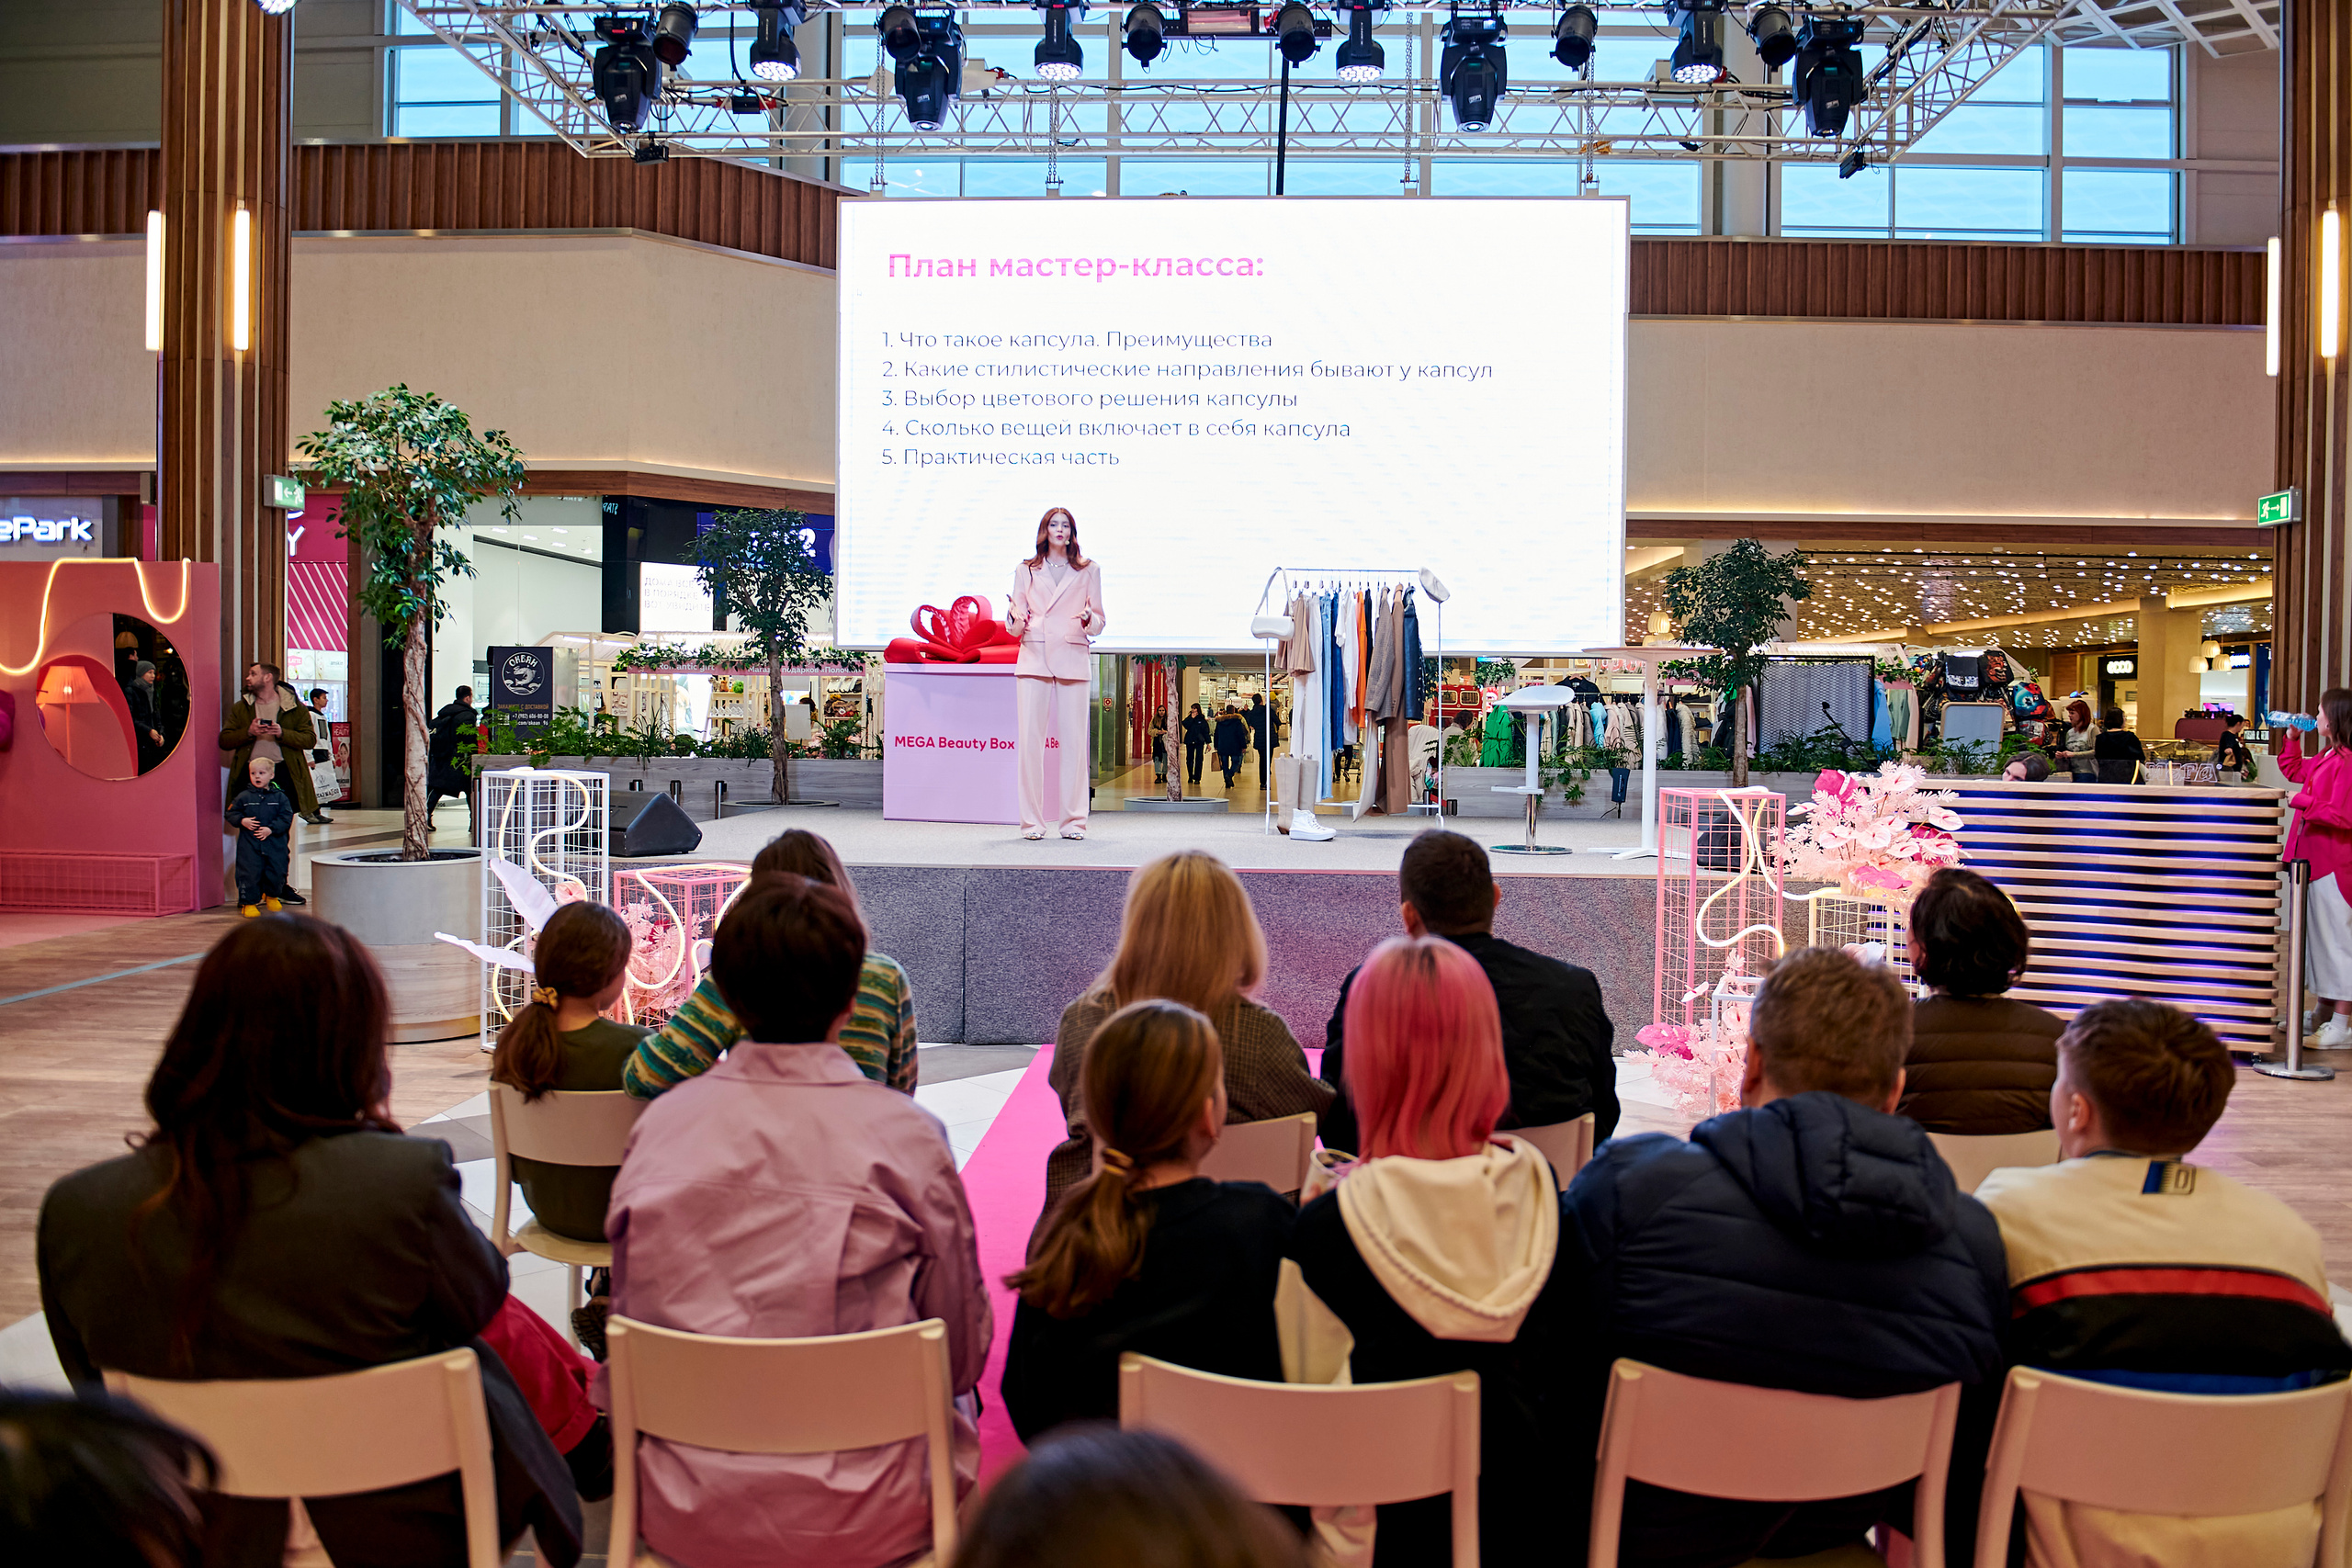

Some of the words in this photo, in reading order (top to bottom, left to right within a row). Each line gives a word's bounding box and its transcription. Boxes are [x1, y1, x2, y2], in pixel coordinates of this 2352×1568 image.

[888, 254, 977, 277] План
[989, 256, 1264, 283] мастер-класса:
[882, 332, 894, 347] 1.
[899, 332, 937, 348] Что
[943, 334, 1002, 348] такое
[1010, 334, 1101, 351] капсула.
[1106, 332, 1272, 352] Преимущества
[882, 361, 898, 377] 2.
[904, 361, 969, 377] Какие
[975, 363, 1150, 377] стилистические
[1157, 364, 1304, 380] направления
[1310, 360, 1395, 378] бывают
[1398, 365, 1412, 381] у
[1418, 365, 1492, 381] капсул
[881, 390, 898, 406] 3.
[904, 389, 976, 410] Выбор
[982, 393, 1093, 409] цветового
[1100, 393, 1200, 410] решения
[1206, 393, 1297, 411] капсулы
[881, 420, 899, 435] 4.
[905, 420, 995, 436] Сколько
[1001, 420, 1071, 439] вещей
[1079, 423, 1182, 436] включает
[1188, 423, 1200, 436] в
[1205, 419, 1256, 436] себя
[1264, 423, 1351, 441] капсула
[881, 449, 897, 465] 5.
[904, 448, 1055, 468] Практическая
[1061, 452, 1120, 466] часть
[894, 736, 935, 748] MEGA
[938, 737, 988, 751] Beauty
[989, 738, 1015, 750] Box
